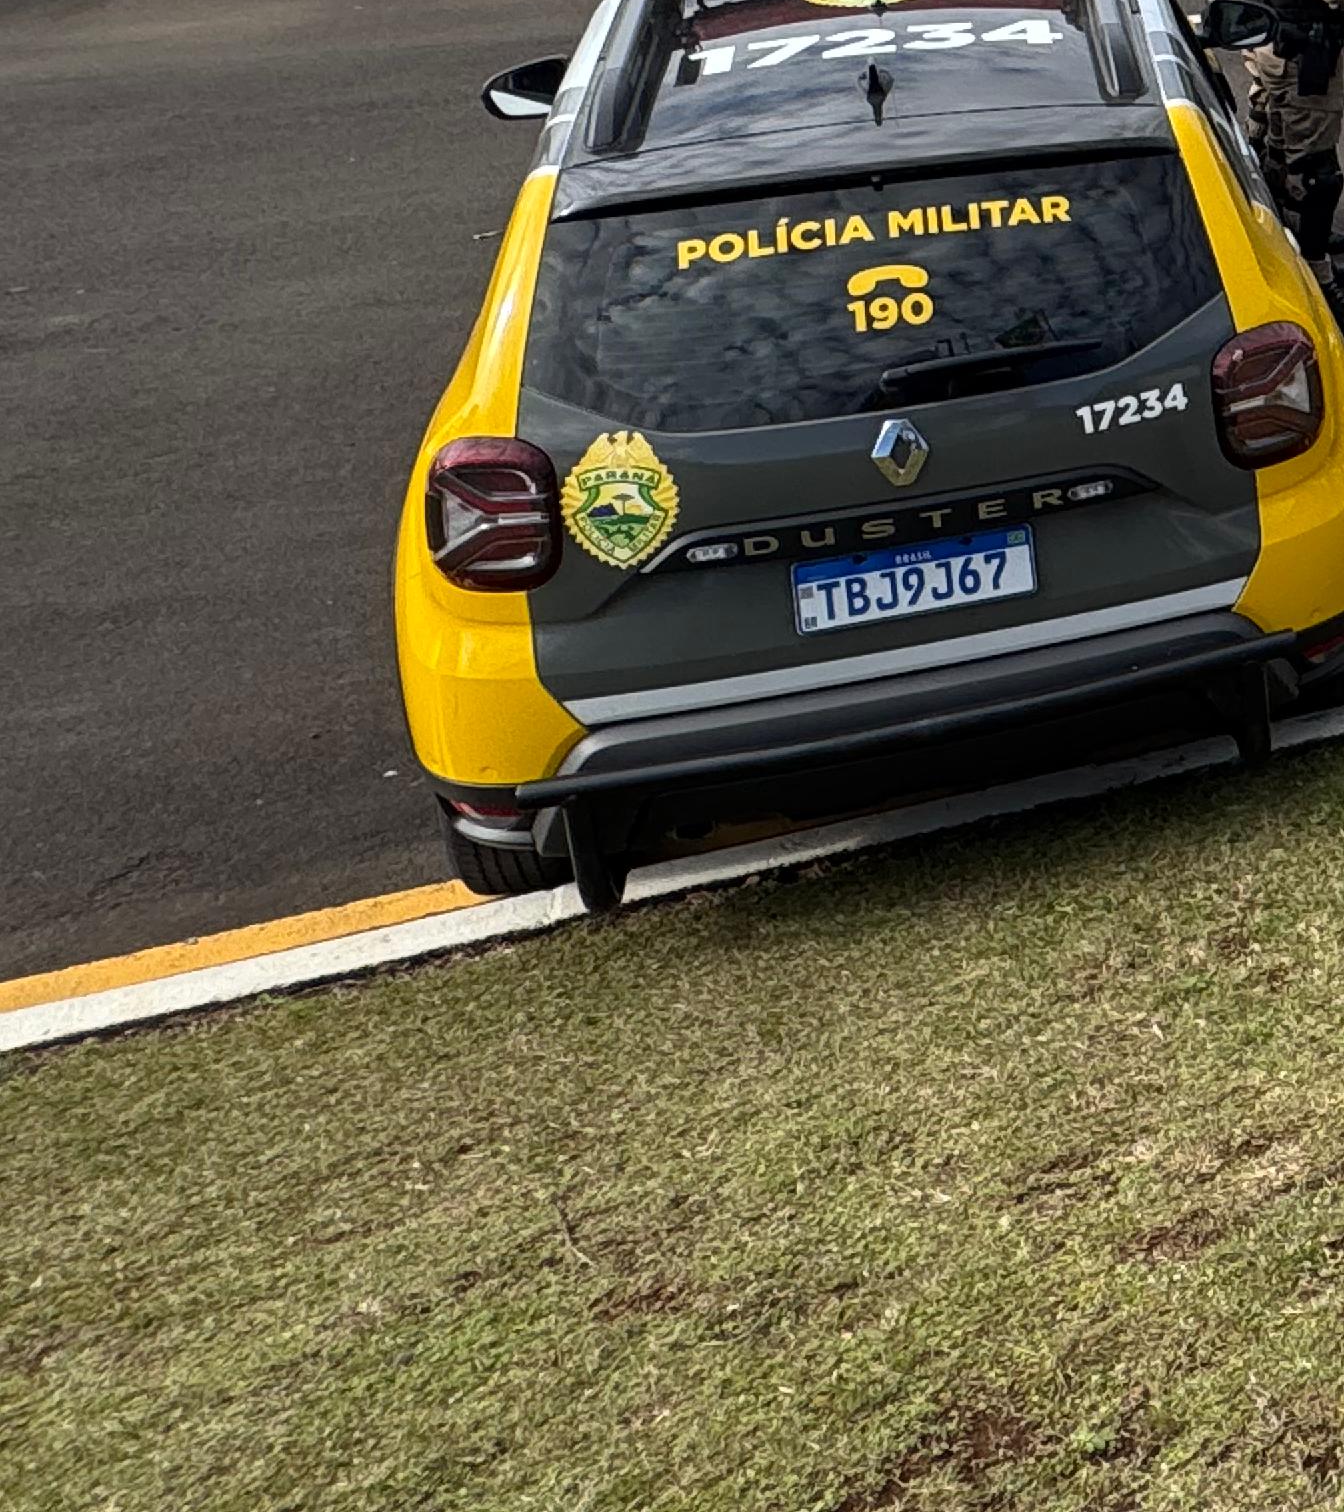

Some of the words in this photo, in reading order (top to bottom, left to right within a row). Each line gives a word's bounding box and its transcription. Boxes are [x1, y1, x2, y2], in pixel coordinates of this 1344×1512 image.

[688, 19, 1063, 76] 17234
[676, 215, 876, 269] POLÍCIA
[886, 194, 1072, 240] MILITAR
[846, 292, 934, 333] 190
[1074, 382, 1189, 435] 17234
[743, 489, 1064, 557] DUSTER
[815, 549, 1009, 621] TBJ9J67
